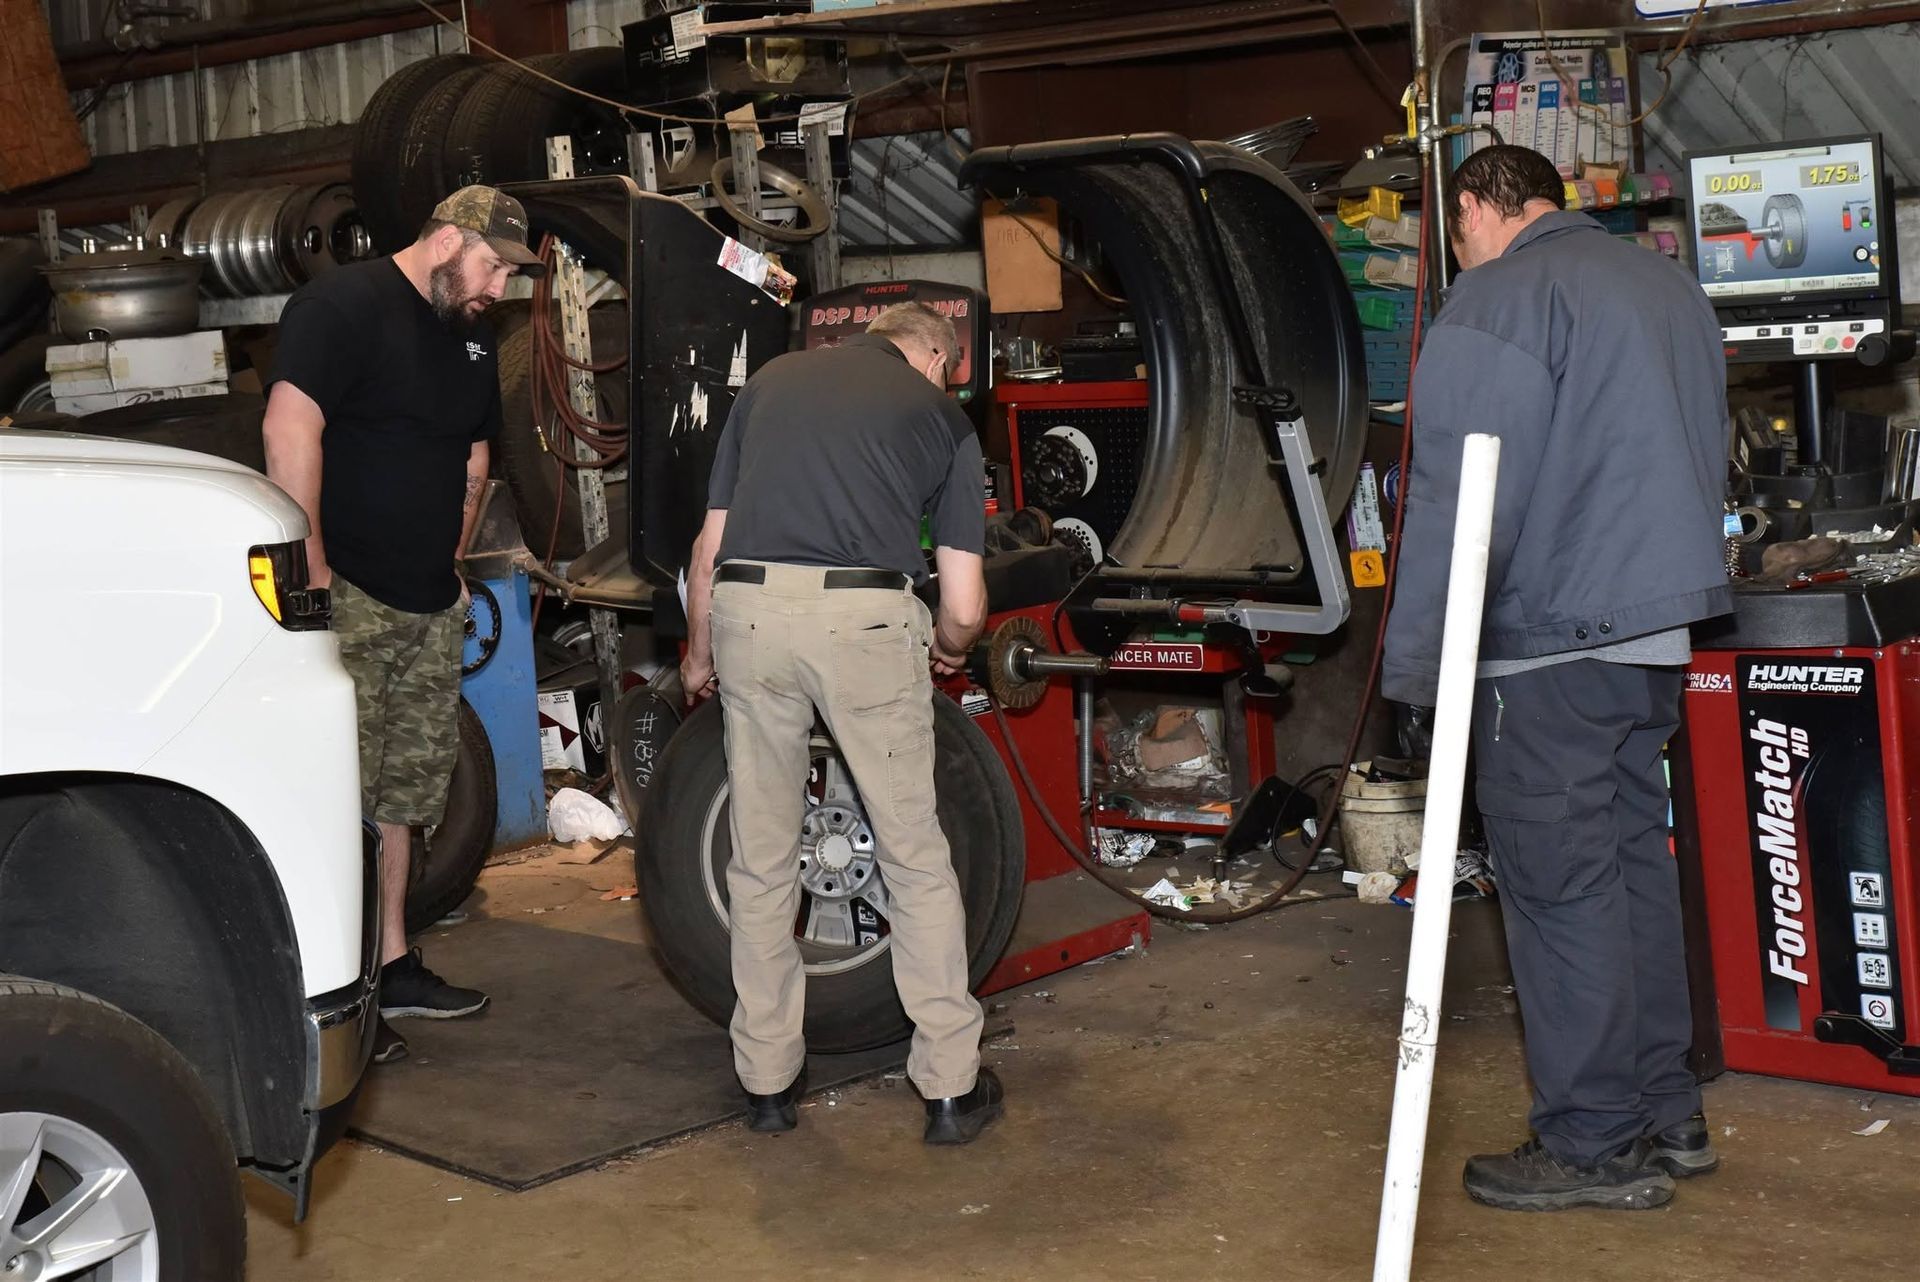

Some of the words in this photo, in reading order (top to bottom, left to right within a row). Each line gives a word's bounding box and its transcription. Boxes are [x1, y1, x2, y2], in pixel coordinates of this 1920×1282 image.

[1711, 174, 1751, 193] 0.00
[1809, 165, 1848, 185] 1.75
[865, 284, 909, 295] HUNTER
[811, 307, 850, 326] DSP
[1157, 651, 1194, 664] MATE
[1690, 681, 1699, 689] IN
[1700, 673, 1732, 690] USA
[1749, 664, 1864, 683] HUNTER
[1748, 680, 1809, 693] Engineering
[1810, 682, 1862, 694] Company
[1790, 727, 1810, 759] HD
[1750, 717, 1810, 986] ForceMatch
